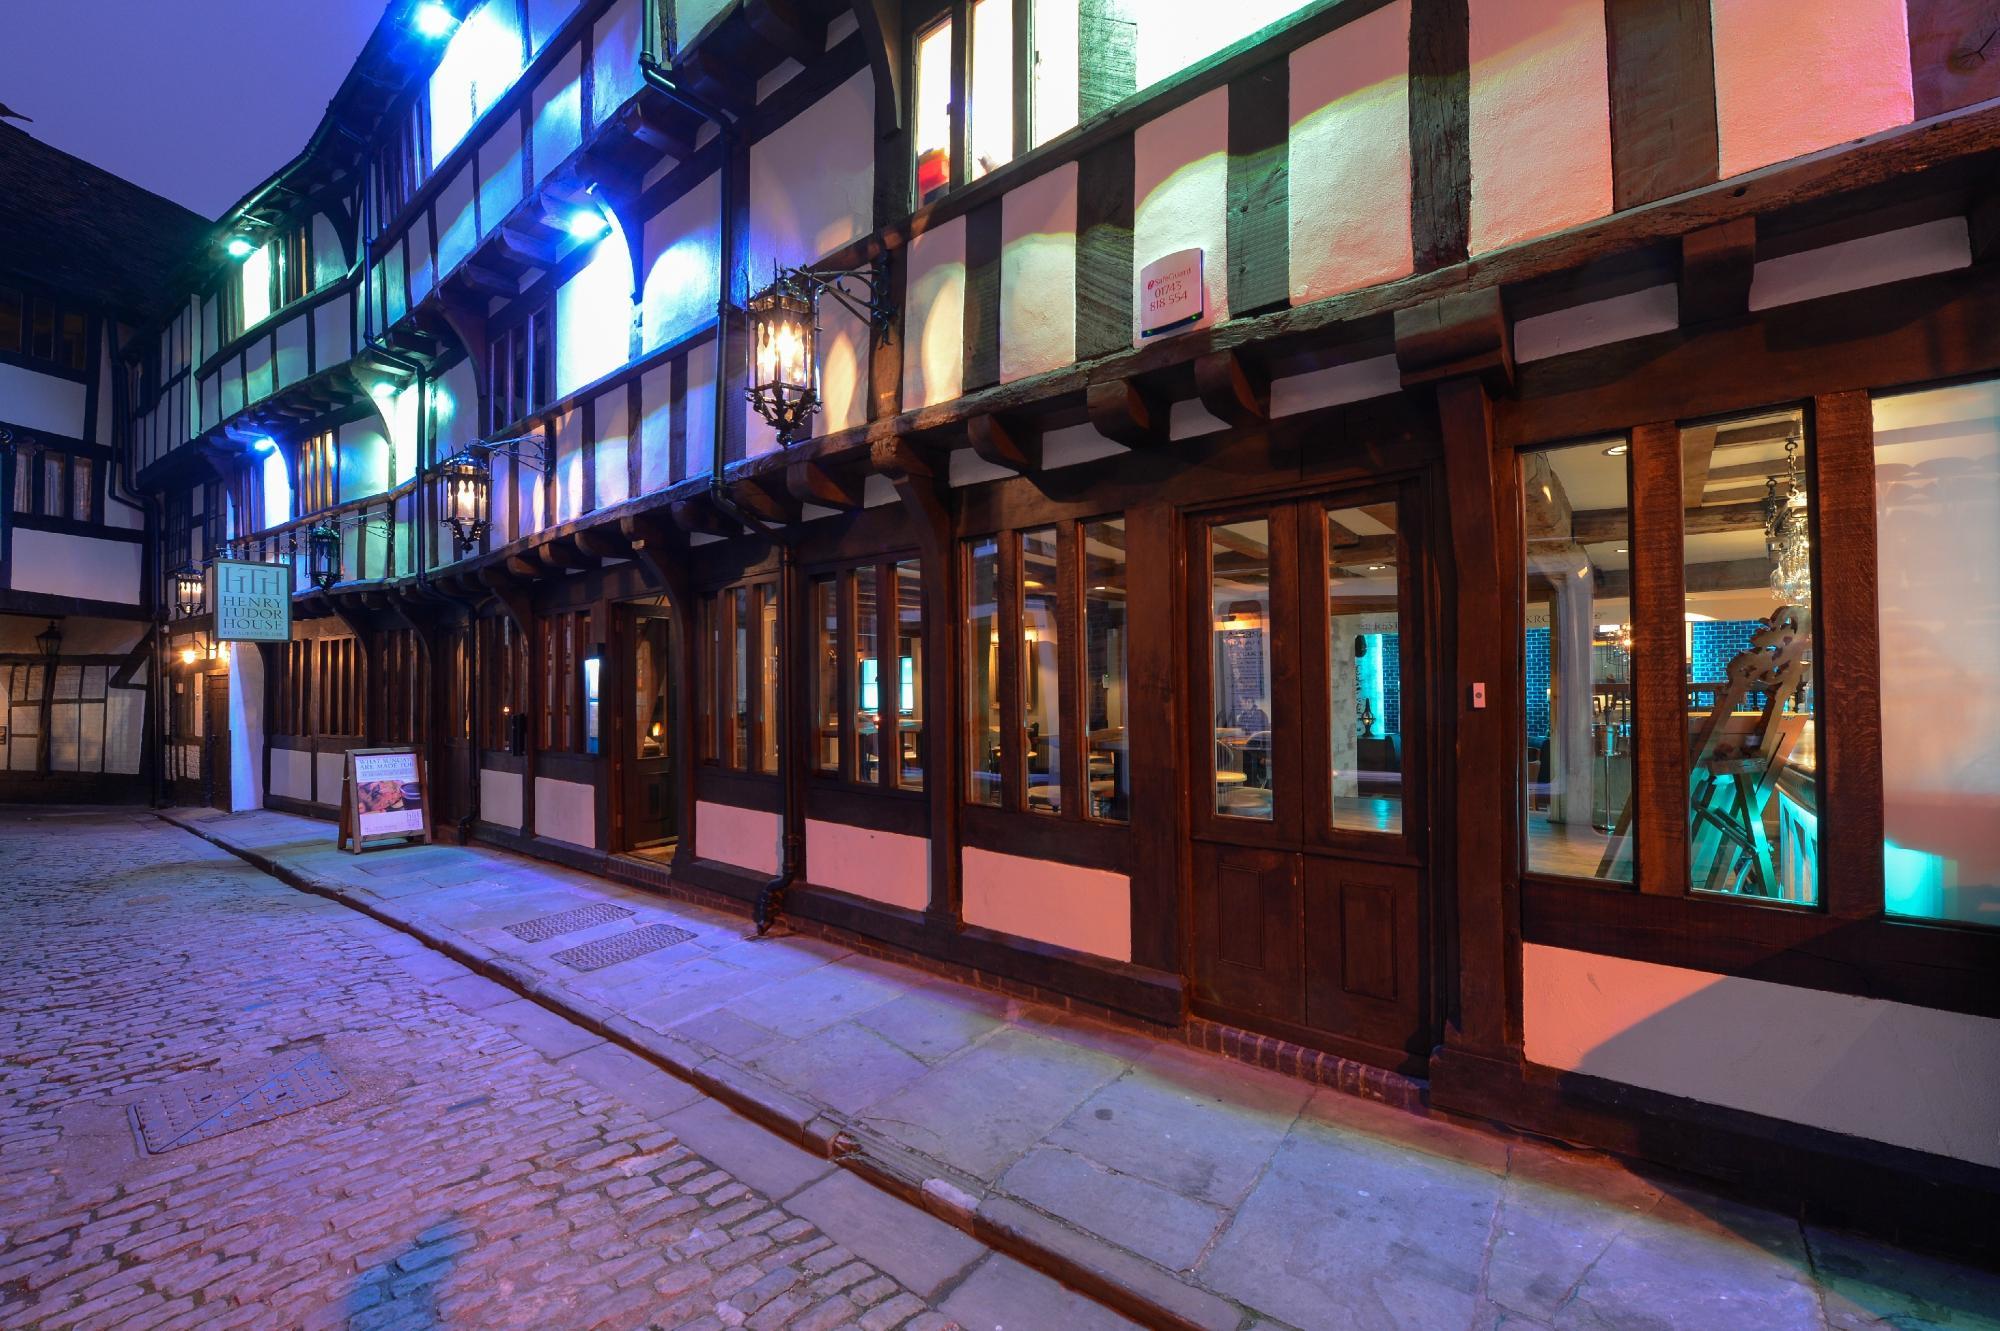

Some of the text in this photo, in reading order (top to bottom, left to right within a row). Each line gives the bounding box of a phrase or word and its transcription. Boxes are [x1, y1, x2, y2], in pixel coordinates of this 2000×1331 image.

[1155, 281, 1182, 298] 01743
[1150, 290, 1187, 312] 818 554
[223, 595, 282, 608] HENRY
[224, 607, 282, 620] TUDOR
[223, 618, 283, 630] HOUSE
